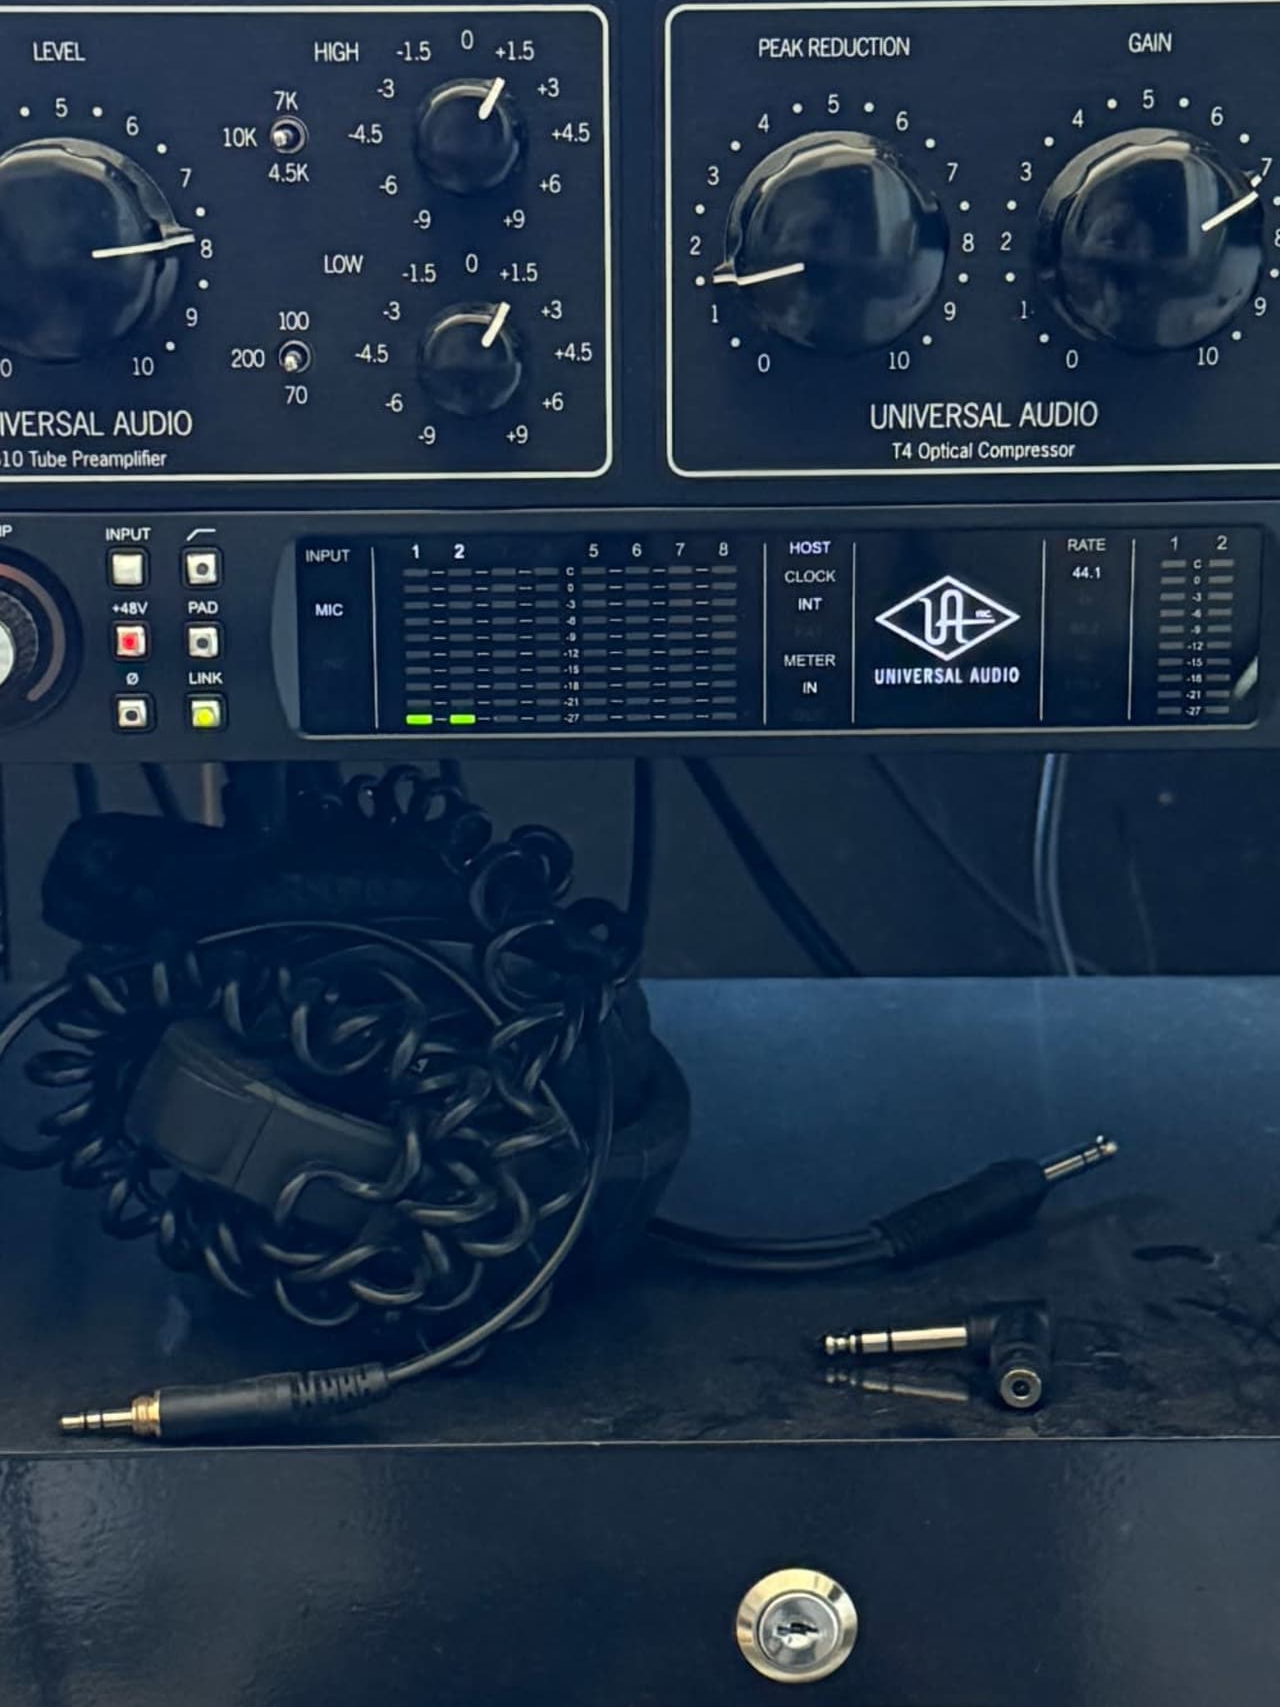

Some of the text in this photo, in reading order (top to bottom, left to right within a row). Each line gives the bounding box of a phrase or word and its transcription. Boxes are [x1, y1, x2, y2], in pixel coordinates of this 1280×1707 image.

[460, 29, 474, 50] 0
[758, 35, 910, 58] PEAK REDUCTION
[1128, 32, 1172, 54] GAIN
[32, 41, 86, 62] LEVEL
[314, 41, 359, 62] HIGH
[396, 40, 432, 62] -1.5
[495, 40, 535, 61] +1.5
[377, 78, 395, 99] -3
[537, 77, 560, 98] +3
[55, 97, 69, 118] 5
[273, 90, 299, 111] 7K
[126, 115, 140, 136] 6
[348, 123, 383, 144] -4.5
[551, 122, 591, 143] +4.5
[223, 126, 258, 148] 10K
[180, 167, 192, 188] 7
[268, 162, 310, 183] 4.5K
[379, 174, 398, 195] -6
[539, 173, 562, 194] +6
[413, 209, 431, 230] -9
[503, 209, 526, 229] +9
[200, 238, 213, 259] 8
[324, 253, 364, 274] LOW
[402, 263, 437, 283] -1.5
[465, 253, 479, 274] 0
[499, 262, 538, 282] +1.5
[185, 307, 198, 327] 9
[383, 300, 401, 321] -3
[541, 299, 563, 320] +3
[278, 310, 310, 331] 100
[231, 348, 266, 369] 200
[354, 343, 389, 363] -4.5
[554, 341, 593, 362] +4.5
[0, 357, 13, 378] 0
[132, 356, 155, 376] 10
[284, 385, 308, 405] 70
[112, 409, 193, 437] AUDIO
[870, 400, 1099, 430] UNIVERSAL AUDIO
[28, 449, 68, 468] Tube
[71, 449, 168, 470] Preamplifier
[892, 440, 1076, 462] T4 Optical Compressor
[105, 527, 152, 542] INPUT
[1067, 537, 1106, 552] RATE
[1170, 536, 1178, 551] 1
[1216, 534, 1228, 551] 2
[305, 548, 351, 563] INPUT
[412, 544, 420, 559] 1
[454, 543, 465, 559] 2
[588, 543, 600, 558] 5
[631, 542, 642, 558] 6
[675, 542, 686, 557] 7
[718, 541, 729, 557] 8
[789, 540, 831, 555] HOST
[784, 569, 836, 584] CLOCK
[1072, 566, 1101, 579] 44.1
[112, 601, 148, 615] +48V
[187, 600, 219, 615] PAD
[315, 603, 344, 617] MIC
[798, 597, 823, 611] INT
[783, 653, 836, 667] METER
[188, 671, 223, 685] LINK
[874, 666, 1020, 685] UNIVERSAL AUDIO
[802, 681, 818, 694] IN
